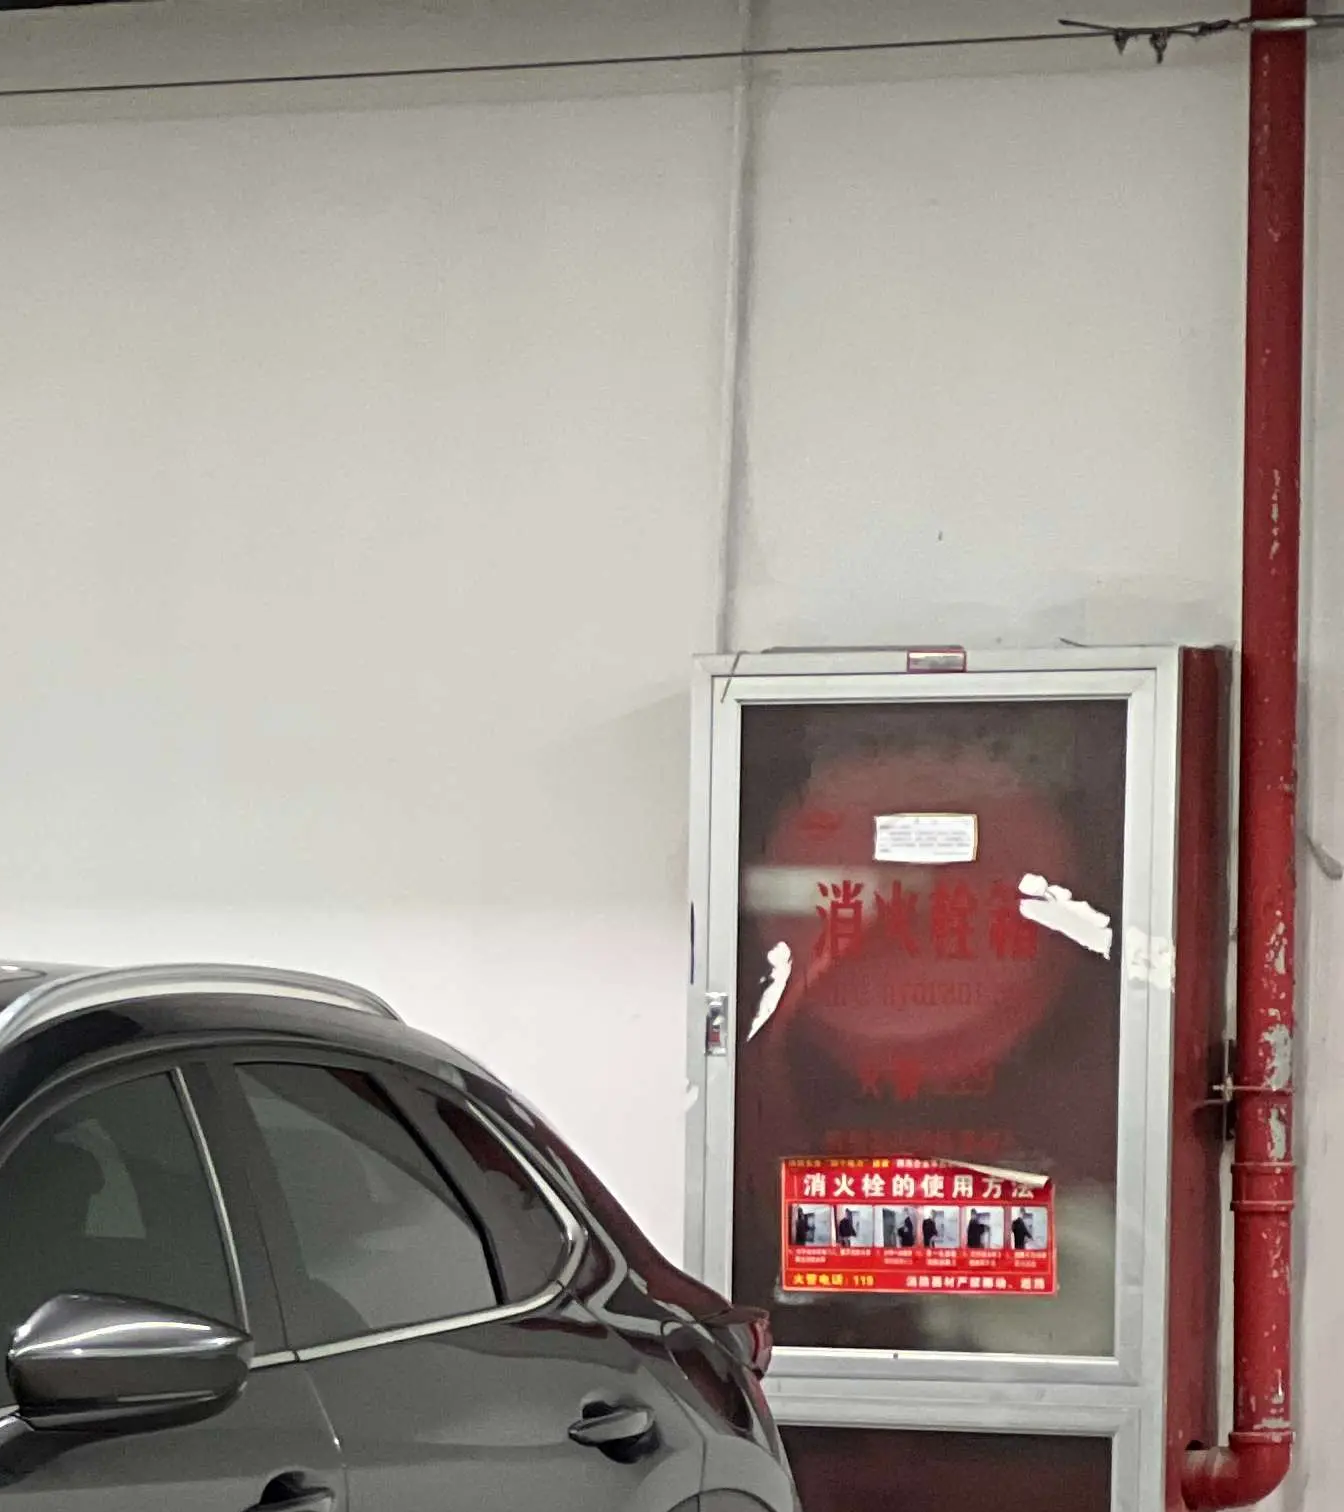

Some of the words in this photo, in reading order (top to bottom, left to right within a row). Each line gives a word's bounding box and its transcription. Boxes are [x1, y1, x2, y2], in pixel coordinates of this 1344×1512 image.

[814, 879, 1039, 960] 消火栓箱
[802, 1172, 1035, 1200] 消火栓的使用方法
